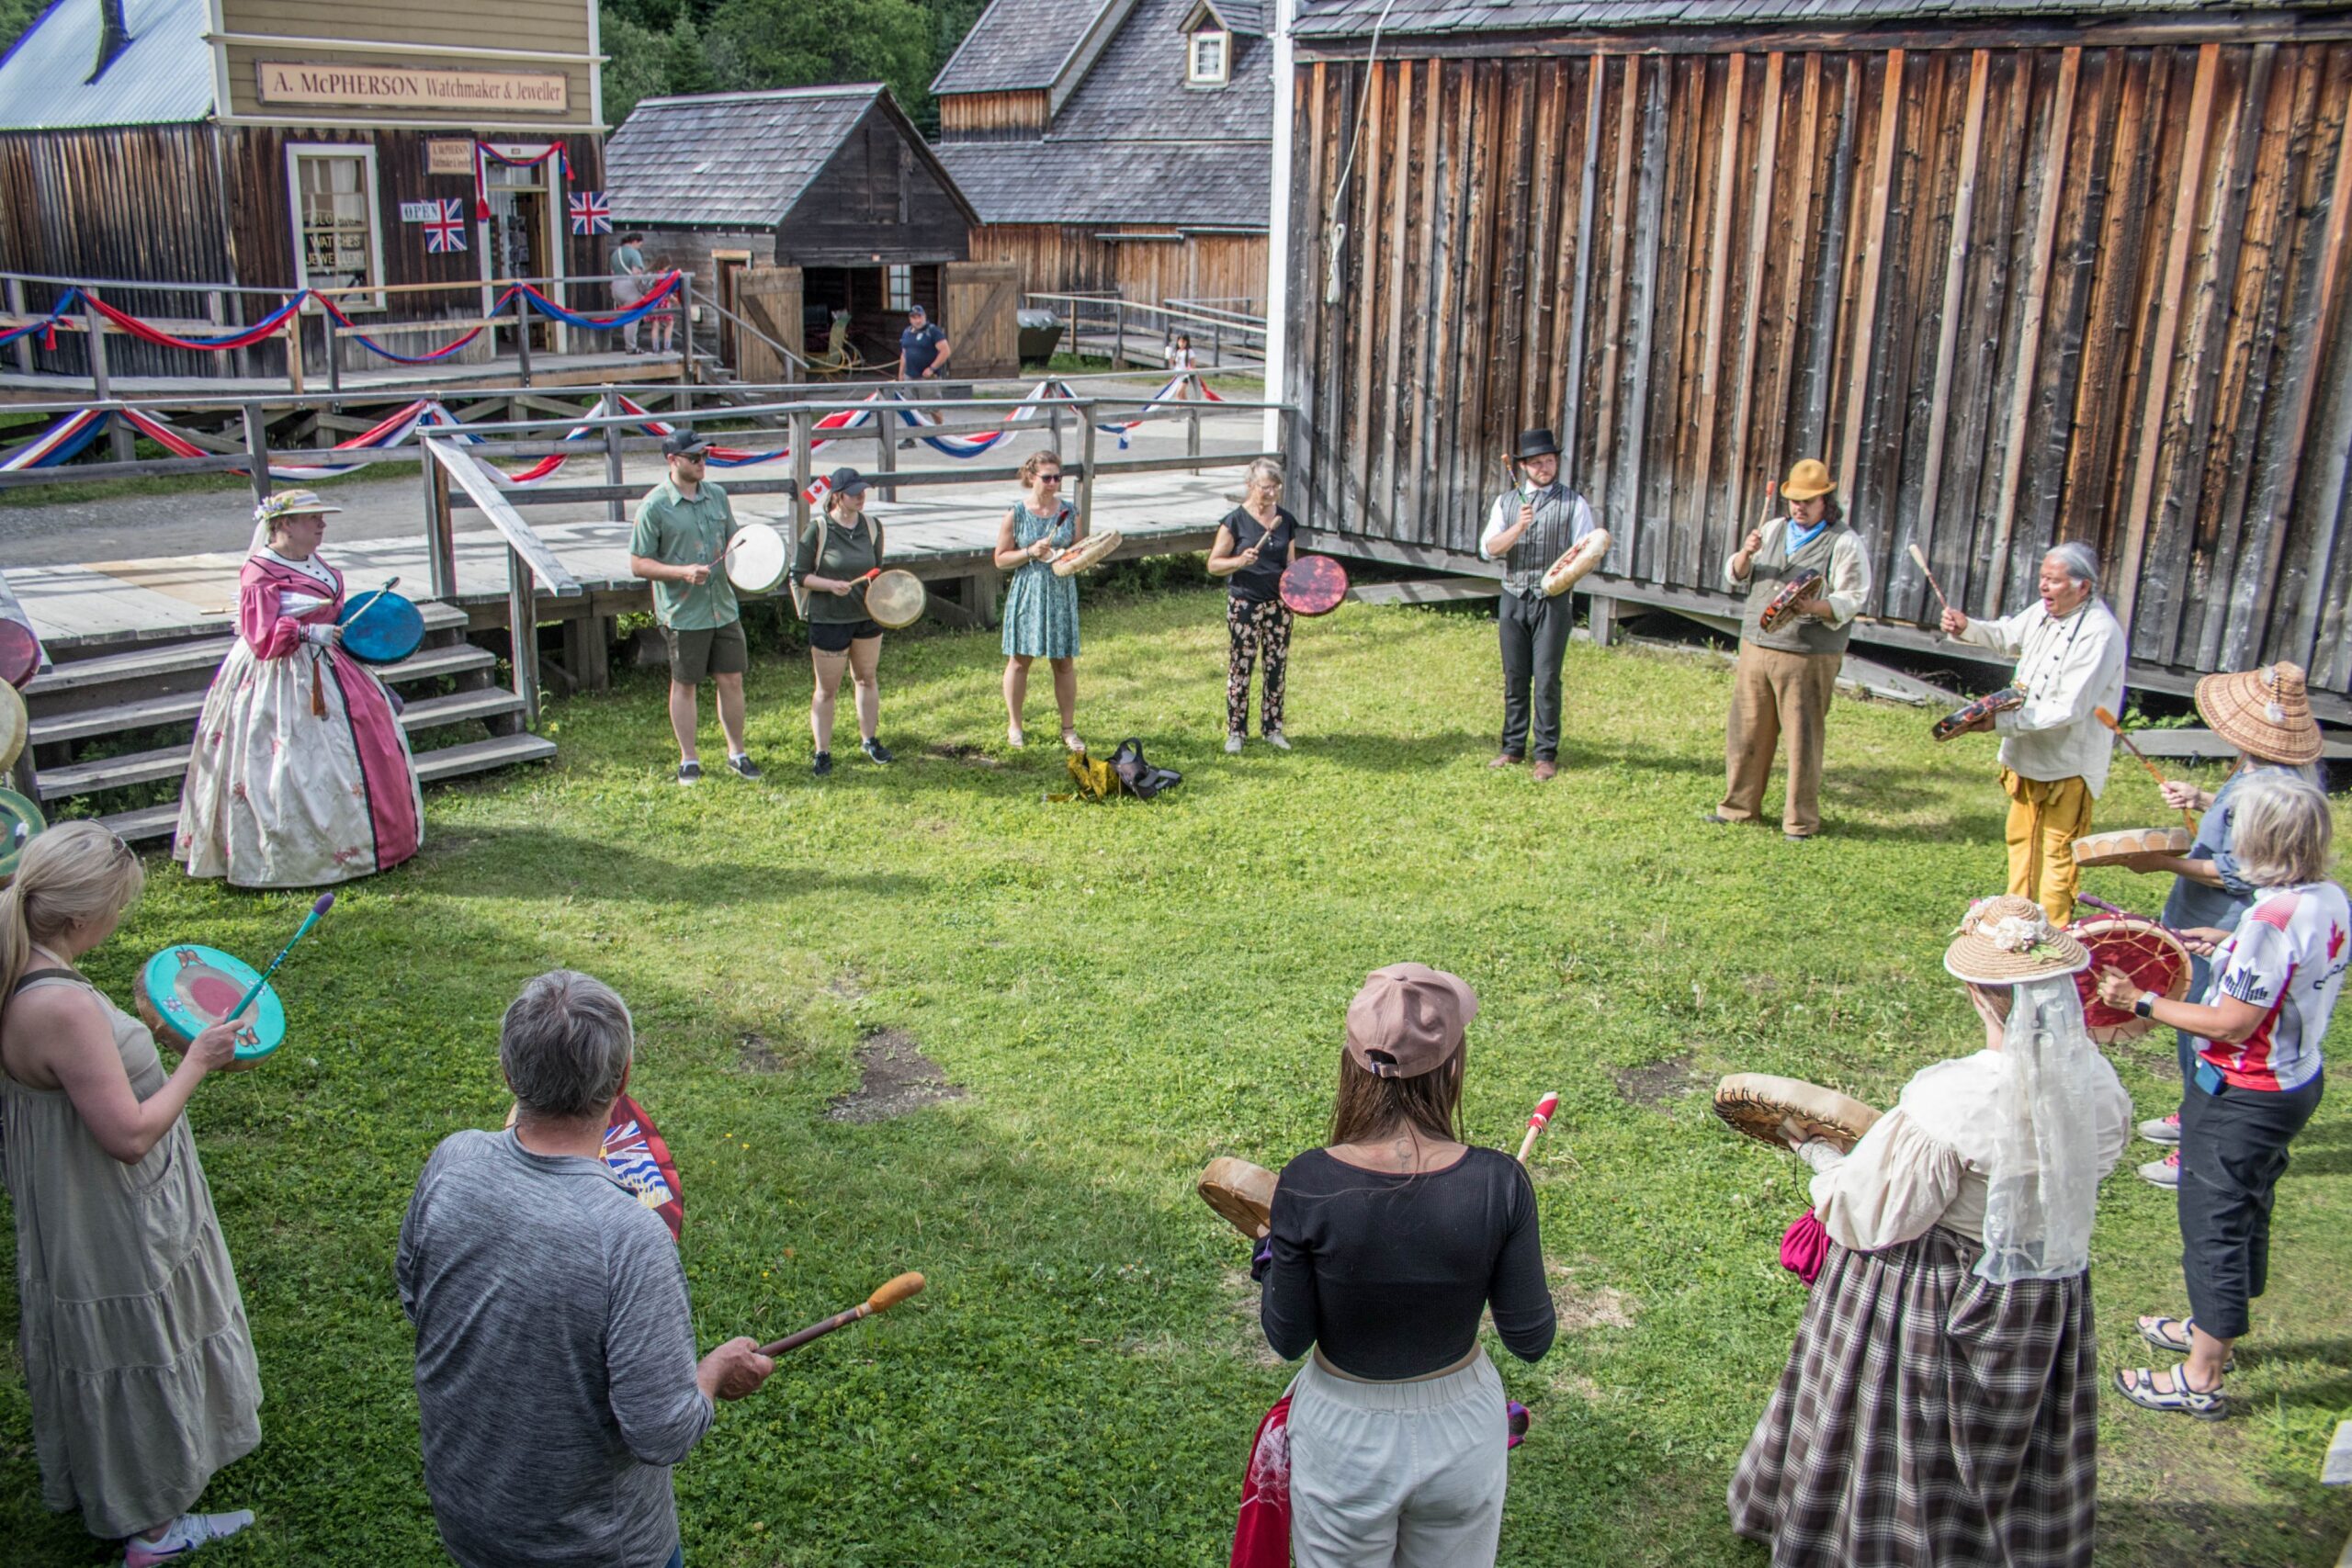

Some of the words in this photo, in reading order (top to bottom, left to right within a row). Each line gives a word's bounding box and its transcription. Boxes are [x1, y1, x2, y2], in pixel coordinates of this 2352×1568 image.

[274, 72, 293, 93] A.
[300, 73, 418, 96] McPHERSON
[425, 77, 501, 99] Watchmaker
[503, 81, 513, 98] &
[515, 82, 561, 102] Jeweller
[404, 205, 438, 220] OPEN
[309, 234, 361, 249] WATCHES
